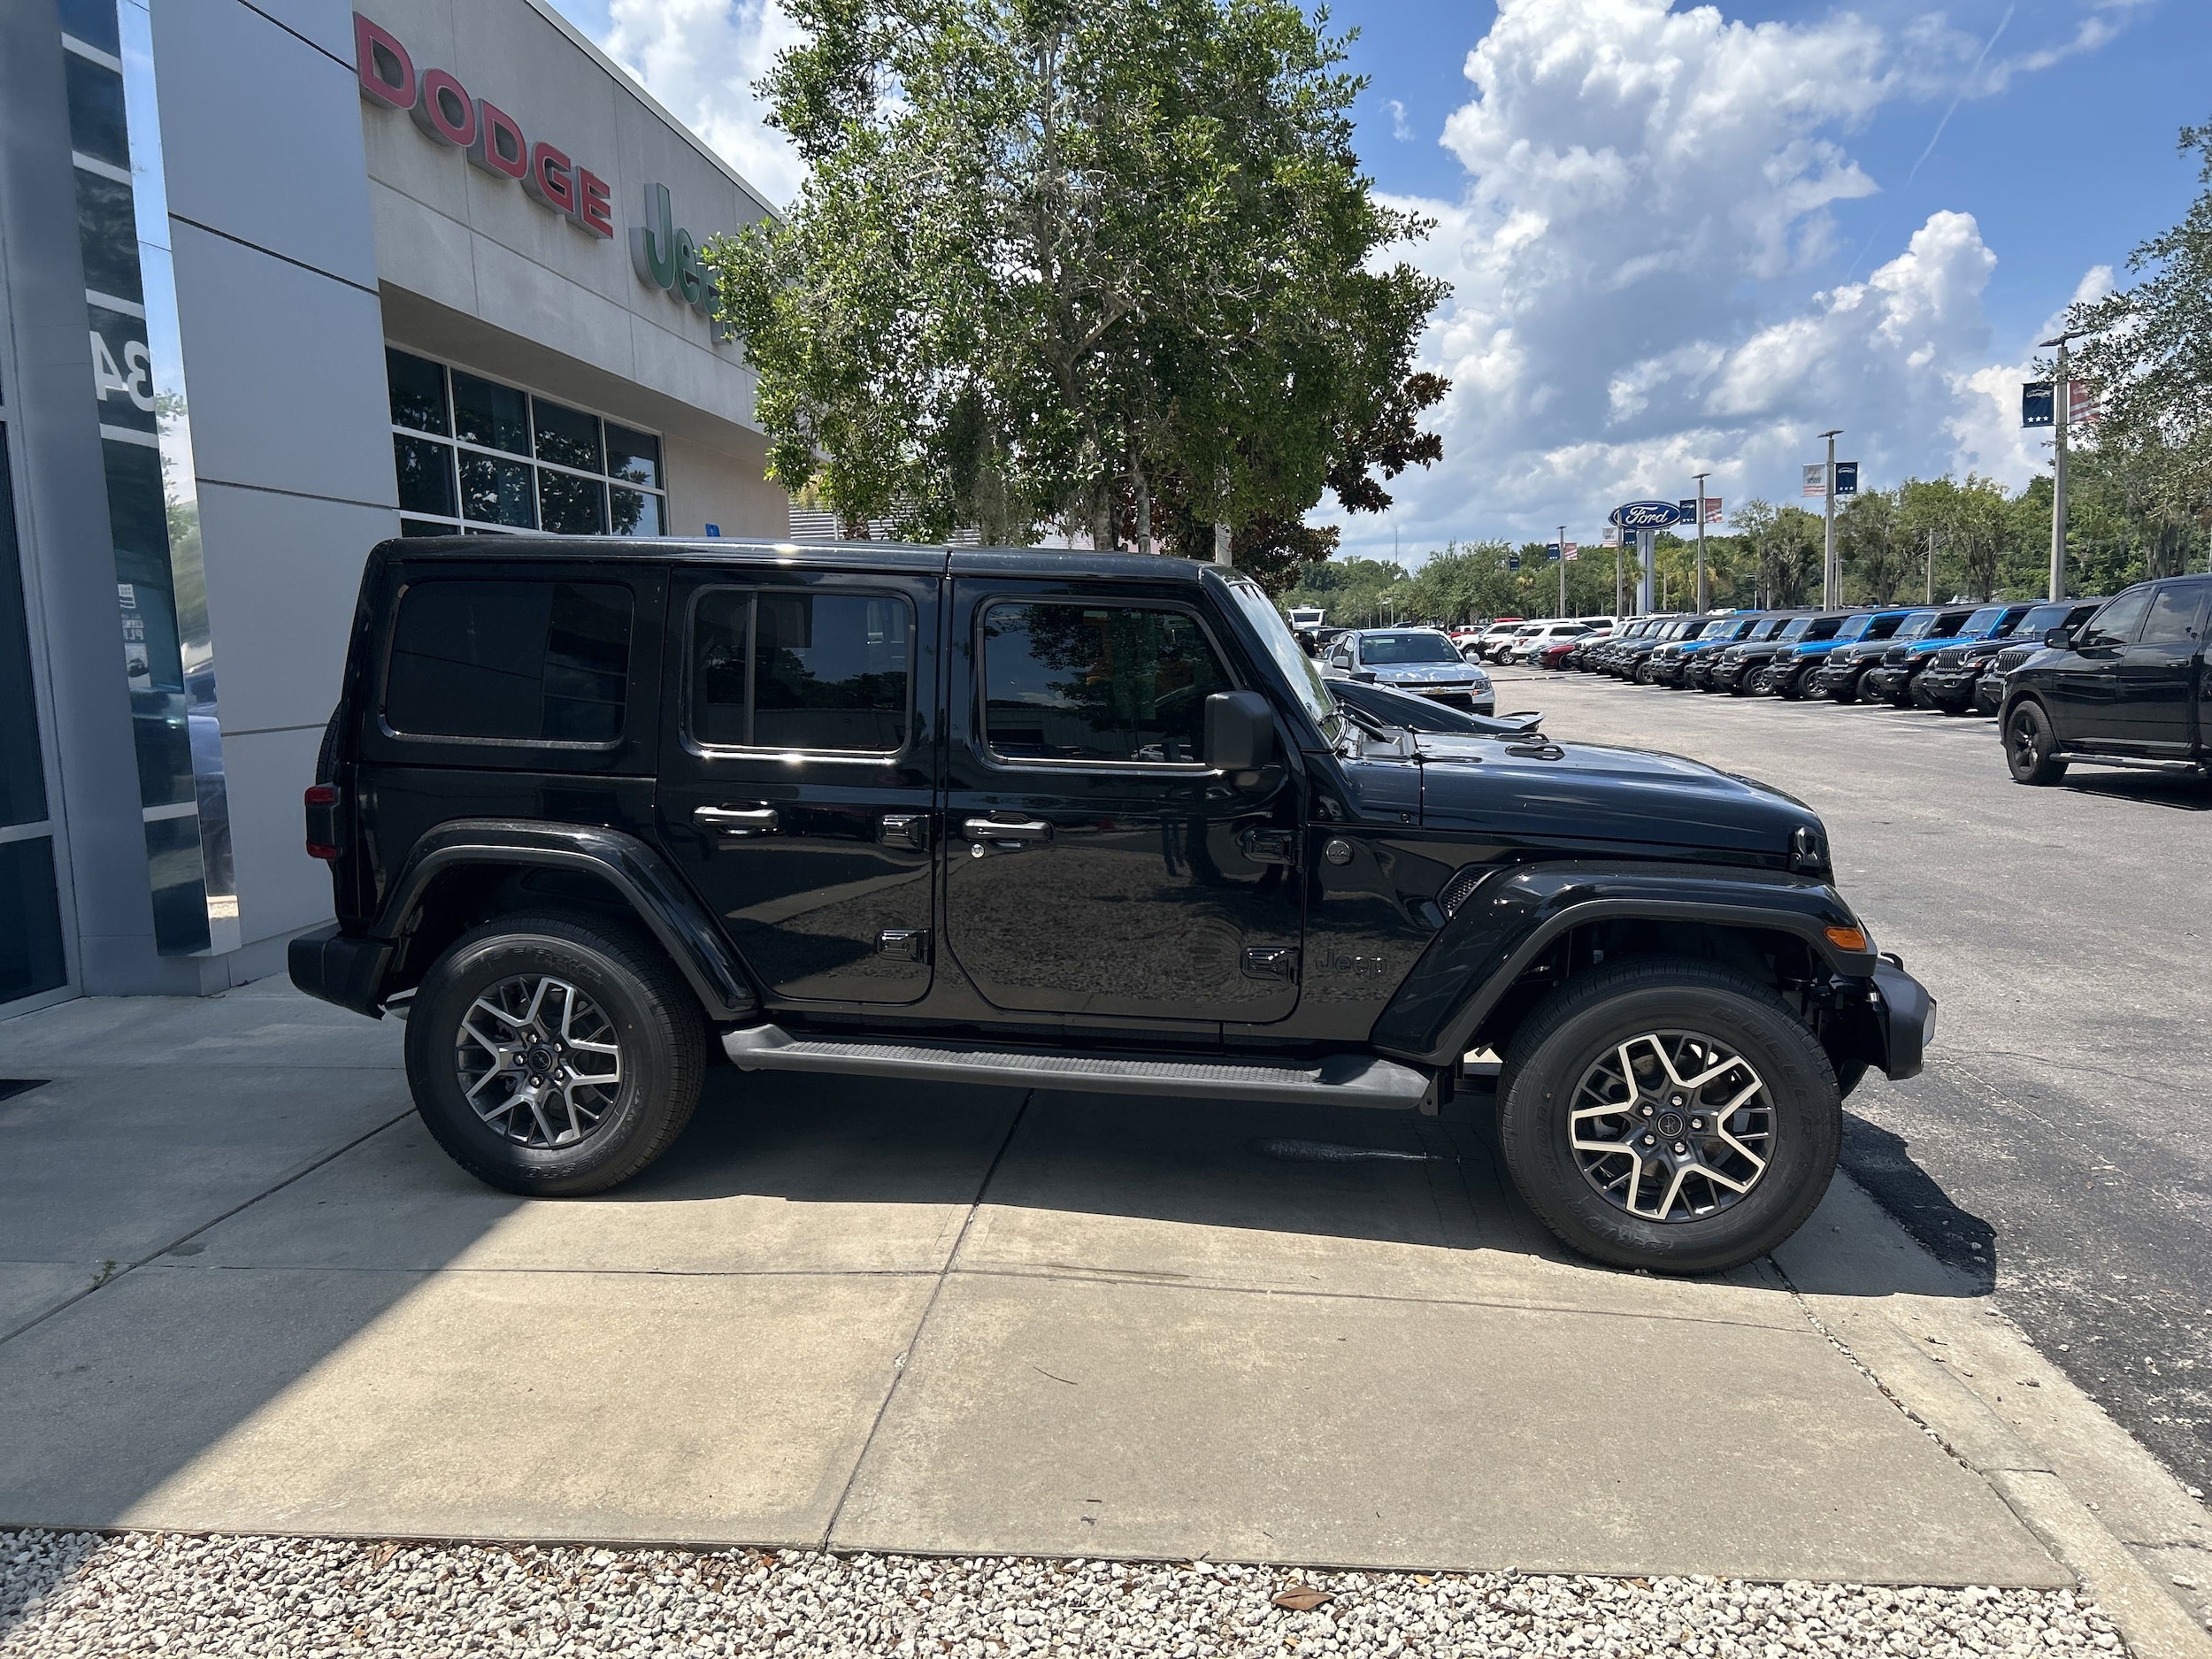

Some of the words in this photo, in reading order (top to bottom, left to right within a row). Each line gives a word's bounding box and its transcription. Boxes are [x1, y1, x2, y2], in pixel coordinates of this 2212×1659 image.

[355, 11, 613, 240] DODGE
[629, 183, 731, 345] Jee
[1625, 506, 1670, 525] Ford
[1316, 949, 1387, 979] Jeep
